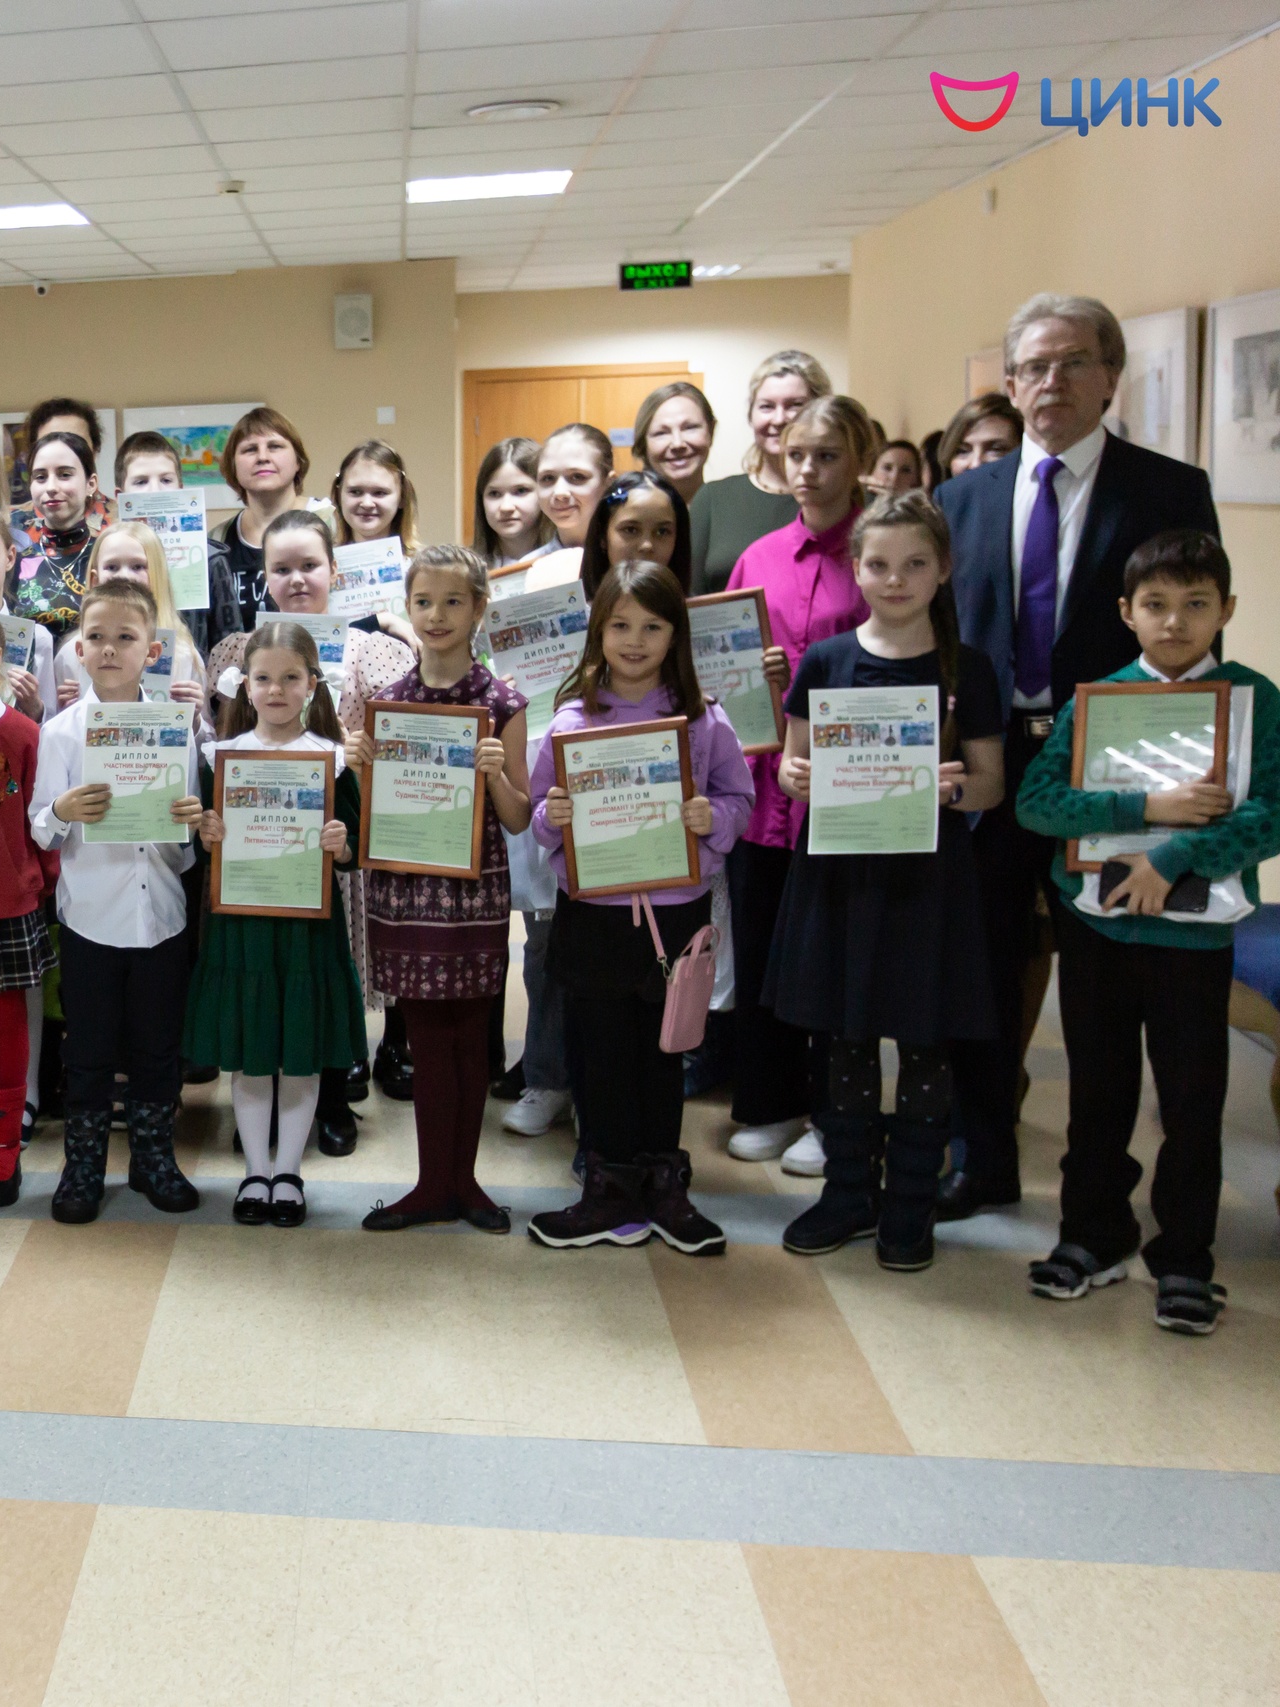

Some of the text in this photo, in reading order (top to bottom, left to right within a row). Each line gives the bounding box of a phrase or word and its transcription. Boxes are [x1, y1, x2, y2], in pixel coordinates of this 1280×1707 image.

[624, 262, 688, 279] ВЫХОД
[345, 591, 380, 602] ДИПЛОМ
[524, 643, 566, 660] ДИПЛОМ
[698, 660, 734, 670] ИПЛОМ
[848, 754, 899, 763] ДИПЛОМ
[403, 770, 446, 779] ДИПЛОМ
[395, 791, 419, 800] Судник
[602, 791, 650, 805] ДИПЛОМ
[254, 815, 296, 823] ДИПЛОМ
